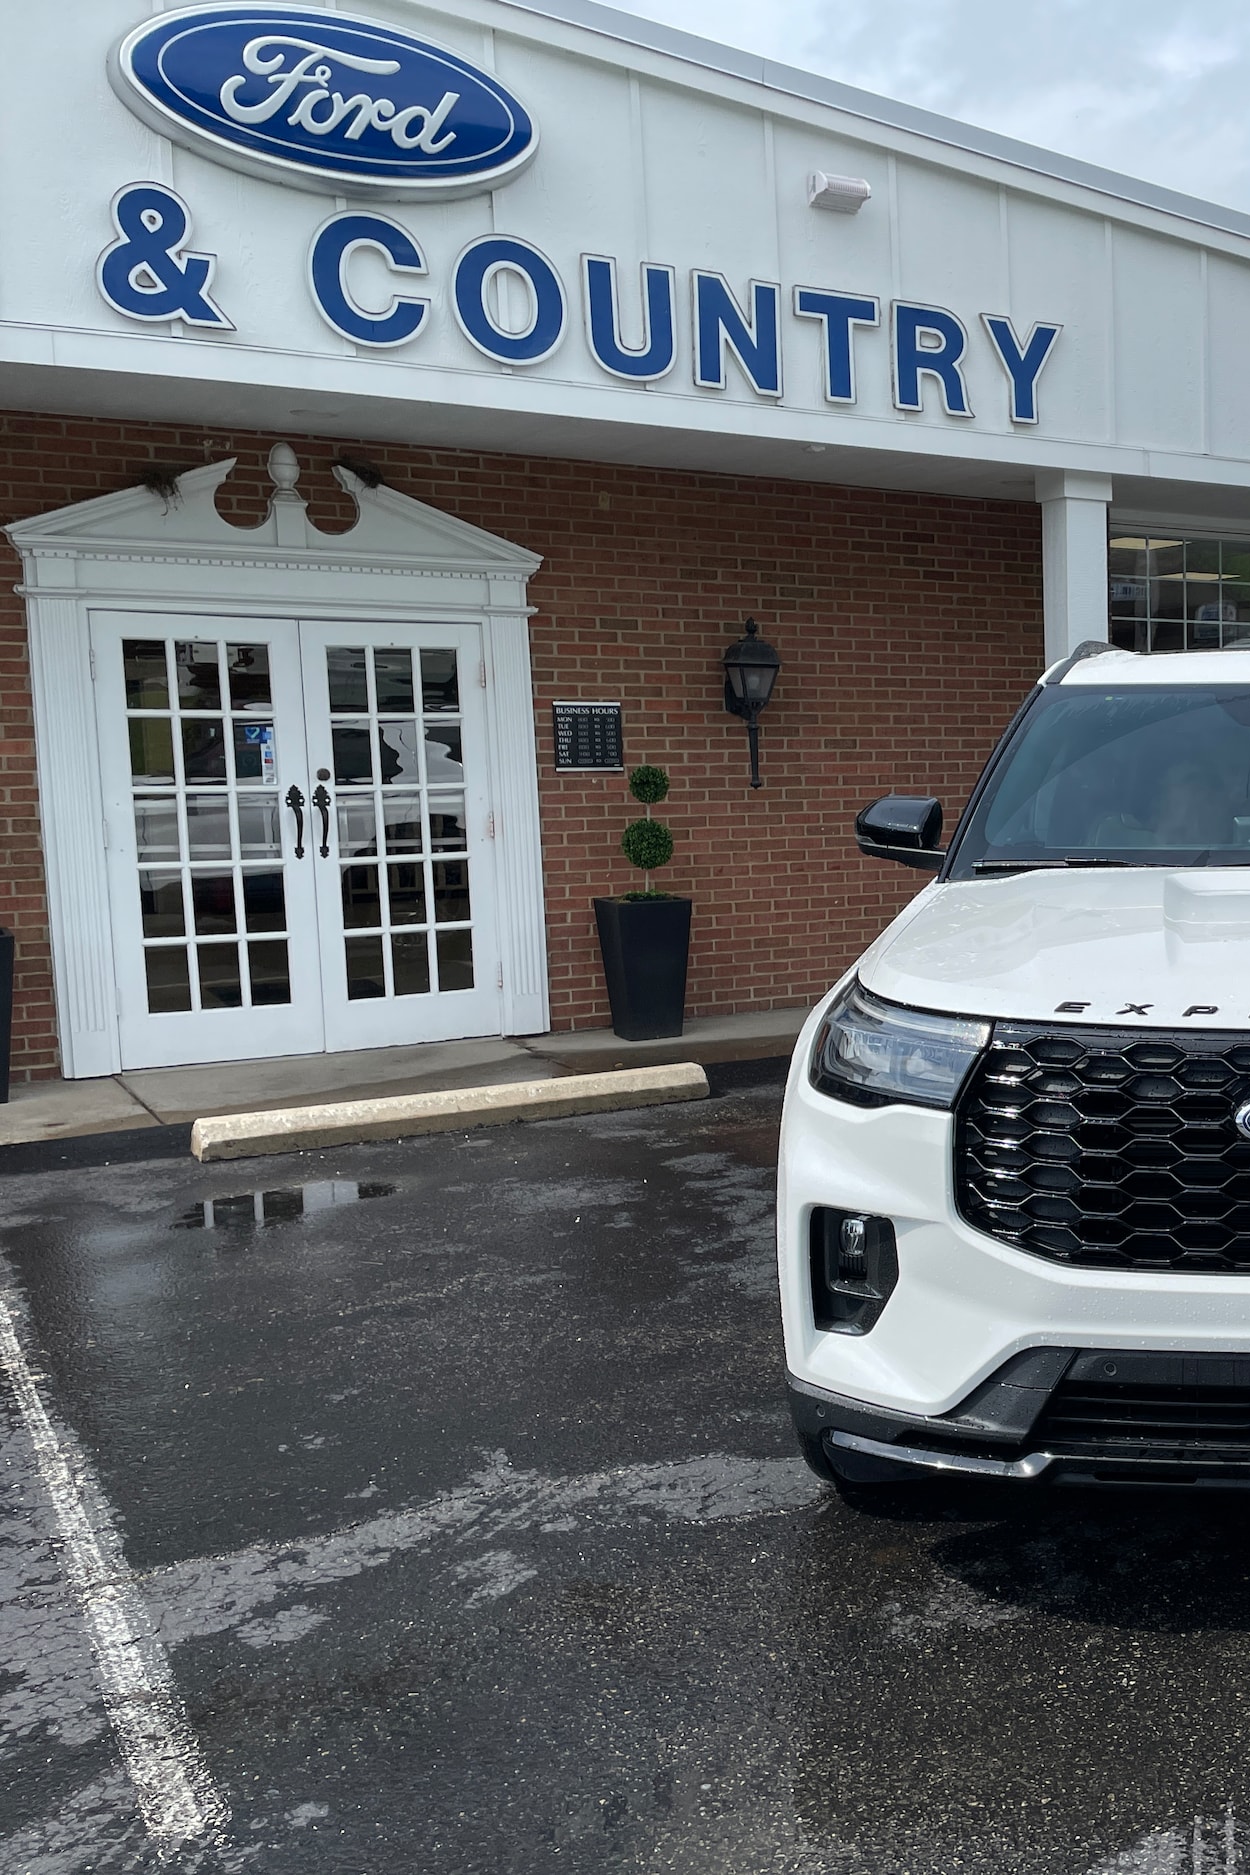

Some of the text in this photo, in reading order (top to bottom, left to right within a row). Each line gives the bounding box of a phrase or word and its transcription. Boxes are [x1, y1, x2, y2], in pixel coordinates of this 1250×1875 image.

[219, 34, 460, 155] Ford
[97, 181, 1064, 425] & COUNTRY
[555, 707, 619, 715] BUSINESS HOURS
